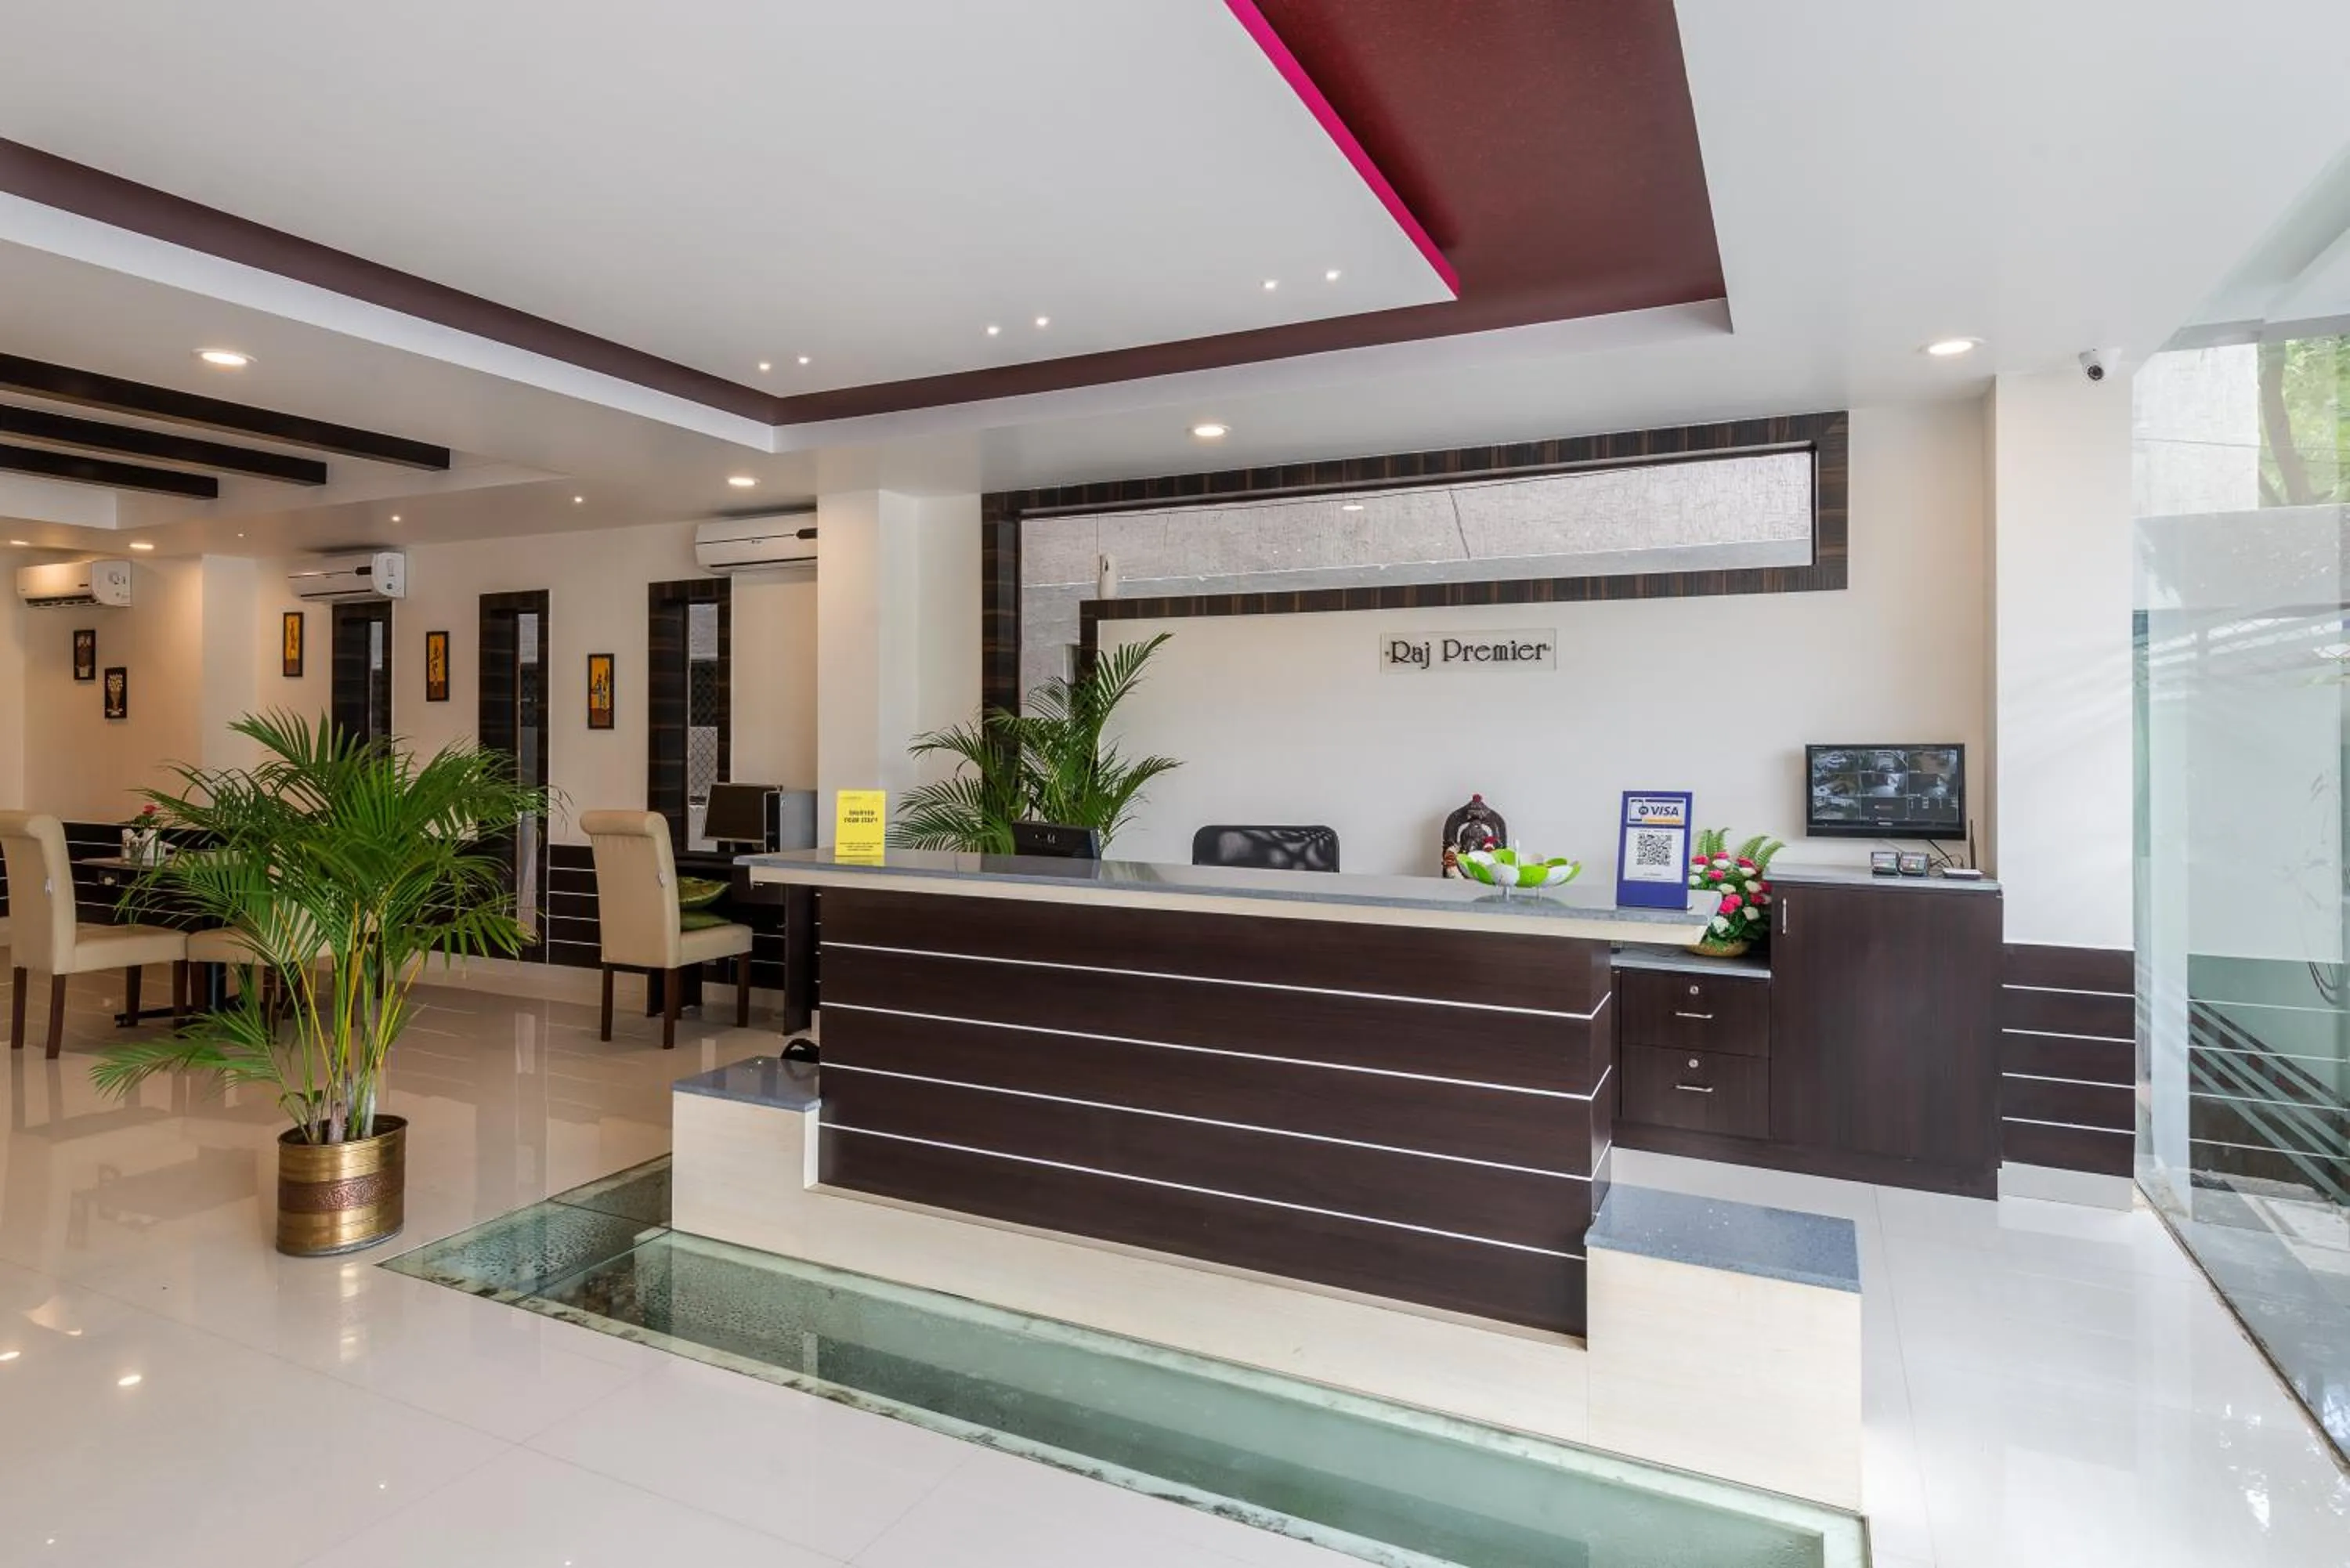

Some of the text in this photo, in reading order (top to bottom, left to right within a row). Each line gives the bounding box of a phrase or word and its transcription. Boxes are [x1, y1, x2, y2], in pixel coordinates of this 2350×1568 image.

[1390, 638, 1547, 669] Raj Premier
[1650, 805, 1679, 816] VISA
